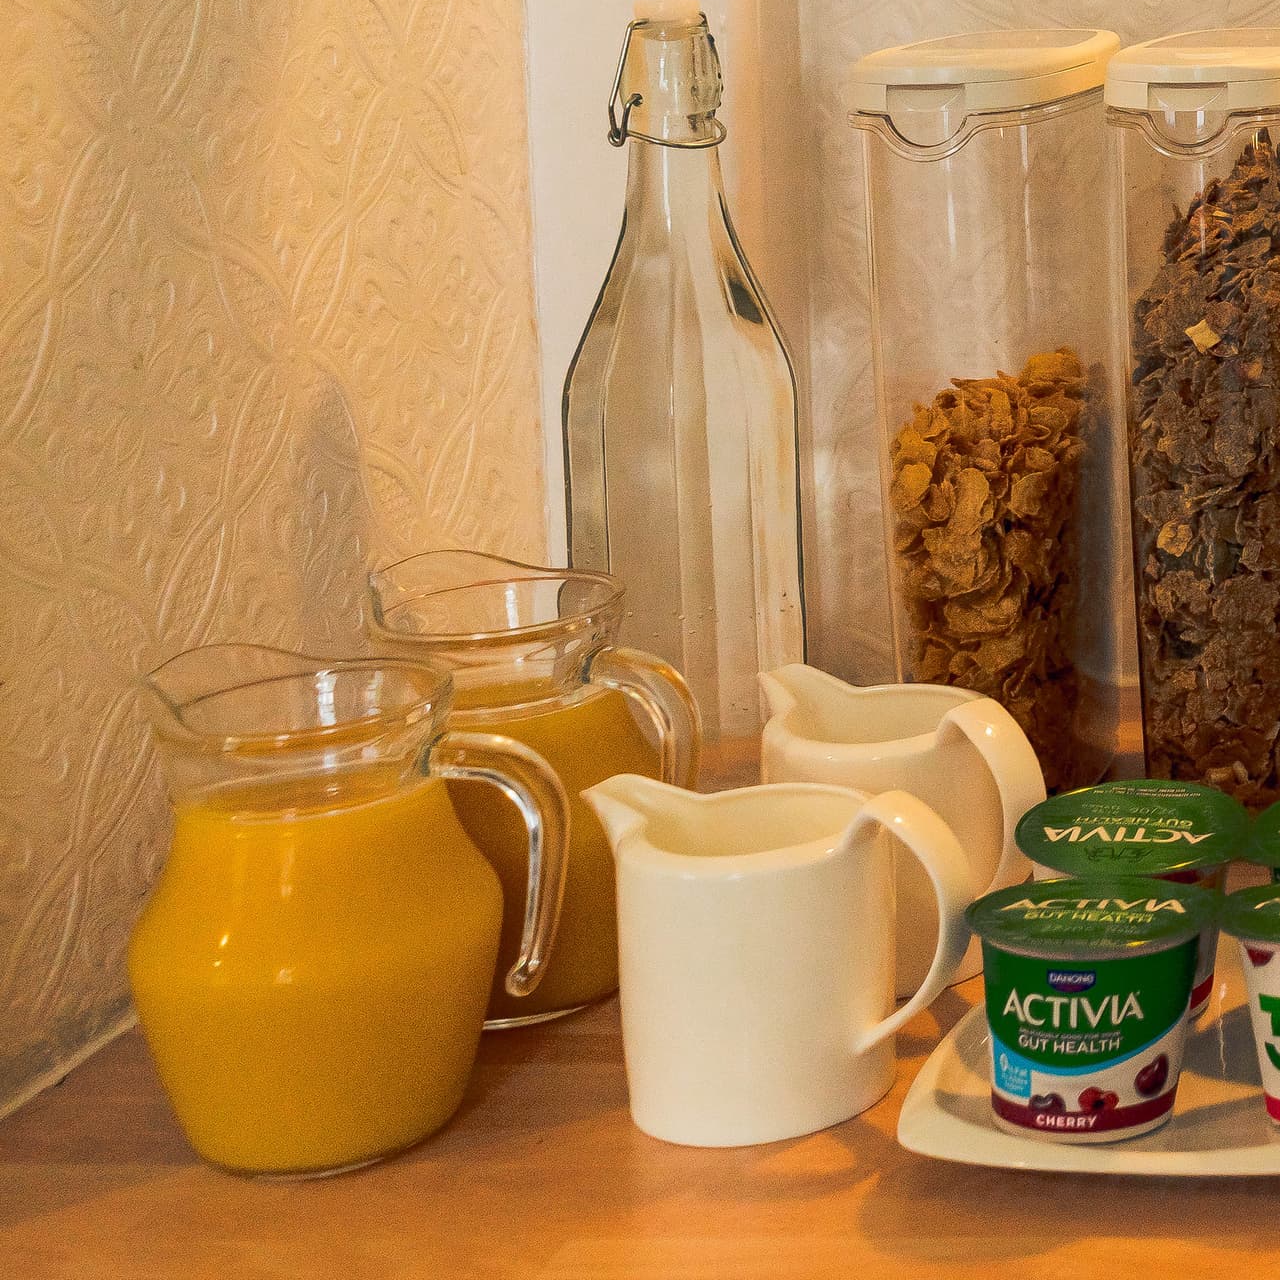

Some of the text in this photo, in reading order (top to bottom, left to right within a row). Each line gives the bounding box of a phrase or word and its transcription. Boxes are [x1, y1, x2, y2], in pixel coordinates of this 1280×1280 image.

[1044, 826, 1216, 844] ACTIVIA
[1000, 898, 1187, 914] ACTIVIA
[1003, 987, 1144, 1029] ACTIVIA
[1018, 1034, 1121, 1054] GUT HEALTH
[1036, 1113, 1098, 1128] CHERRY
